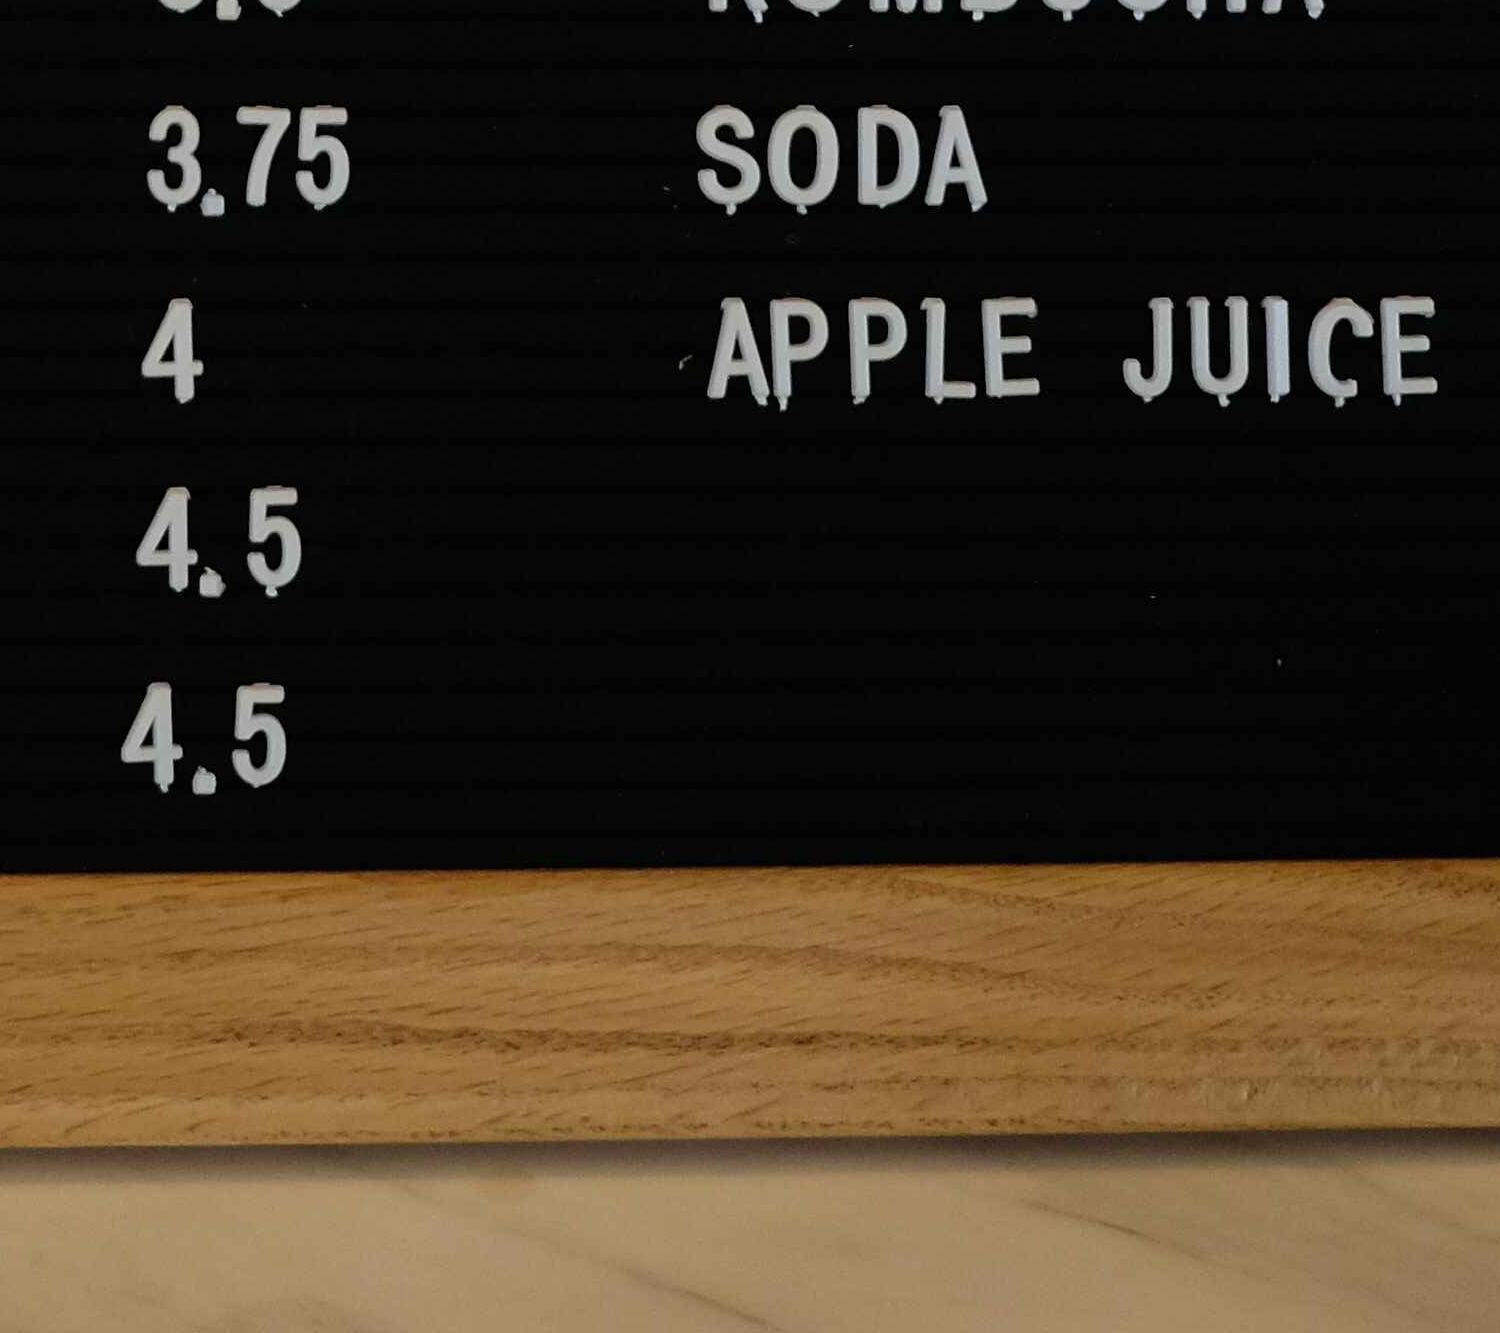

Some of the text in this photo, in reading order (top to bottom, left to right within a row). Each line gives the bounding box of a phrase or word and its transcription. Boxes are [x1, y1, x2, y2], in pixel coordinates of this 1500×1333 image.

[147, 105, 350, 216] 3.75
[696, 104, 988, 215] SODA
[141, 298, 204, 404] 4
[707, 297, 1040, 411] APPLE
[1123, 296, 1438, 408] JUICE
[136, 486, 302, 597] 4.5
[121, 682, 287, 795] 4.5
